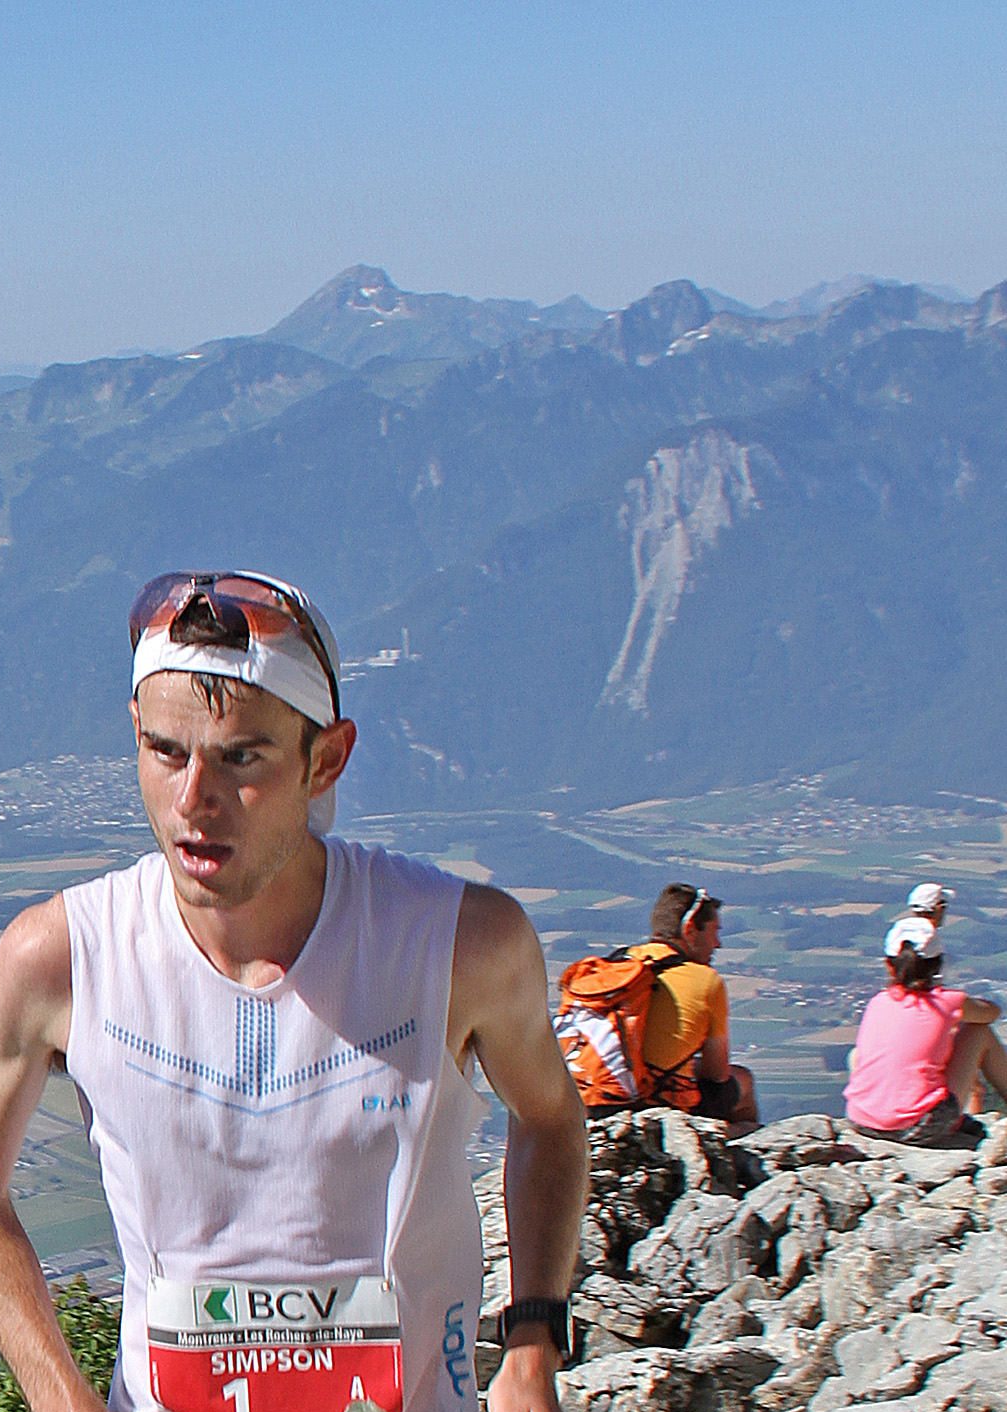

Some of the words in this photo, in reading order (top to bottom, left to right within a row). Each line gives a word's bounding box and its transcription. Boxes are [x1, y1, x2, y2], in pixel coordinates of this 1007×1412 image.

[249, 1287, 338, 1320] BCV
[178, 1331, 235, 1347] Montreux
[244, 1329, 263, 1343] Les
[211, 1347, 333, 1376] SIMPSON
